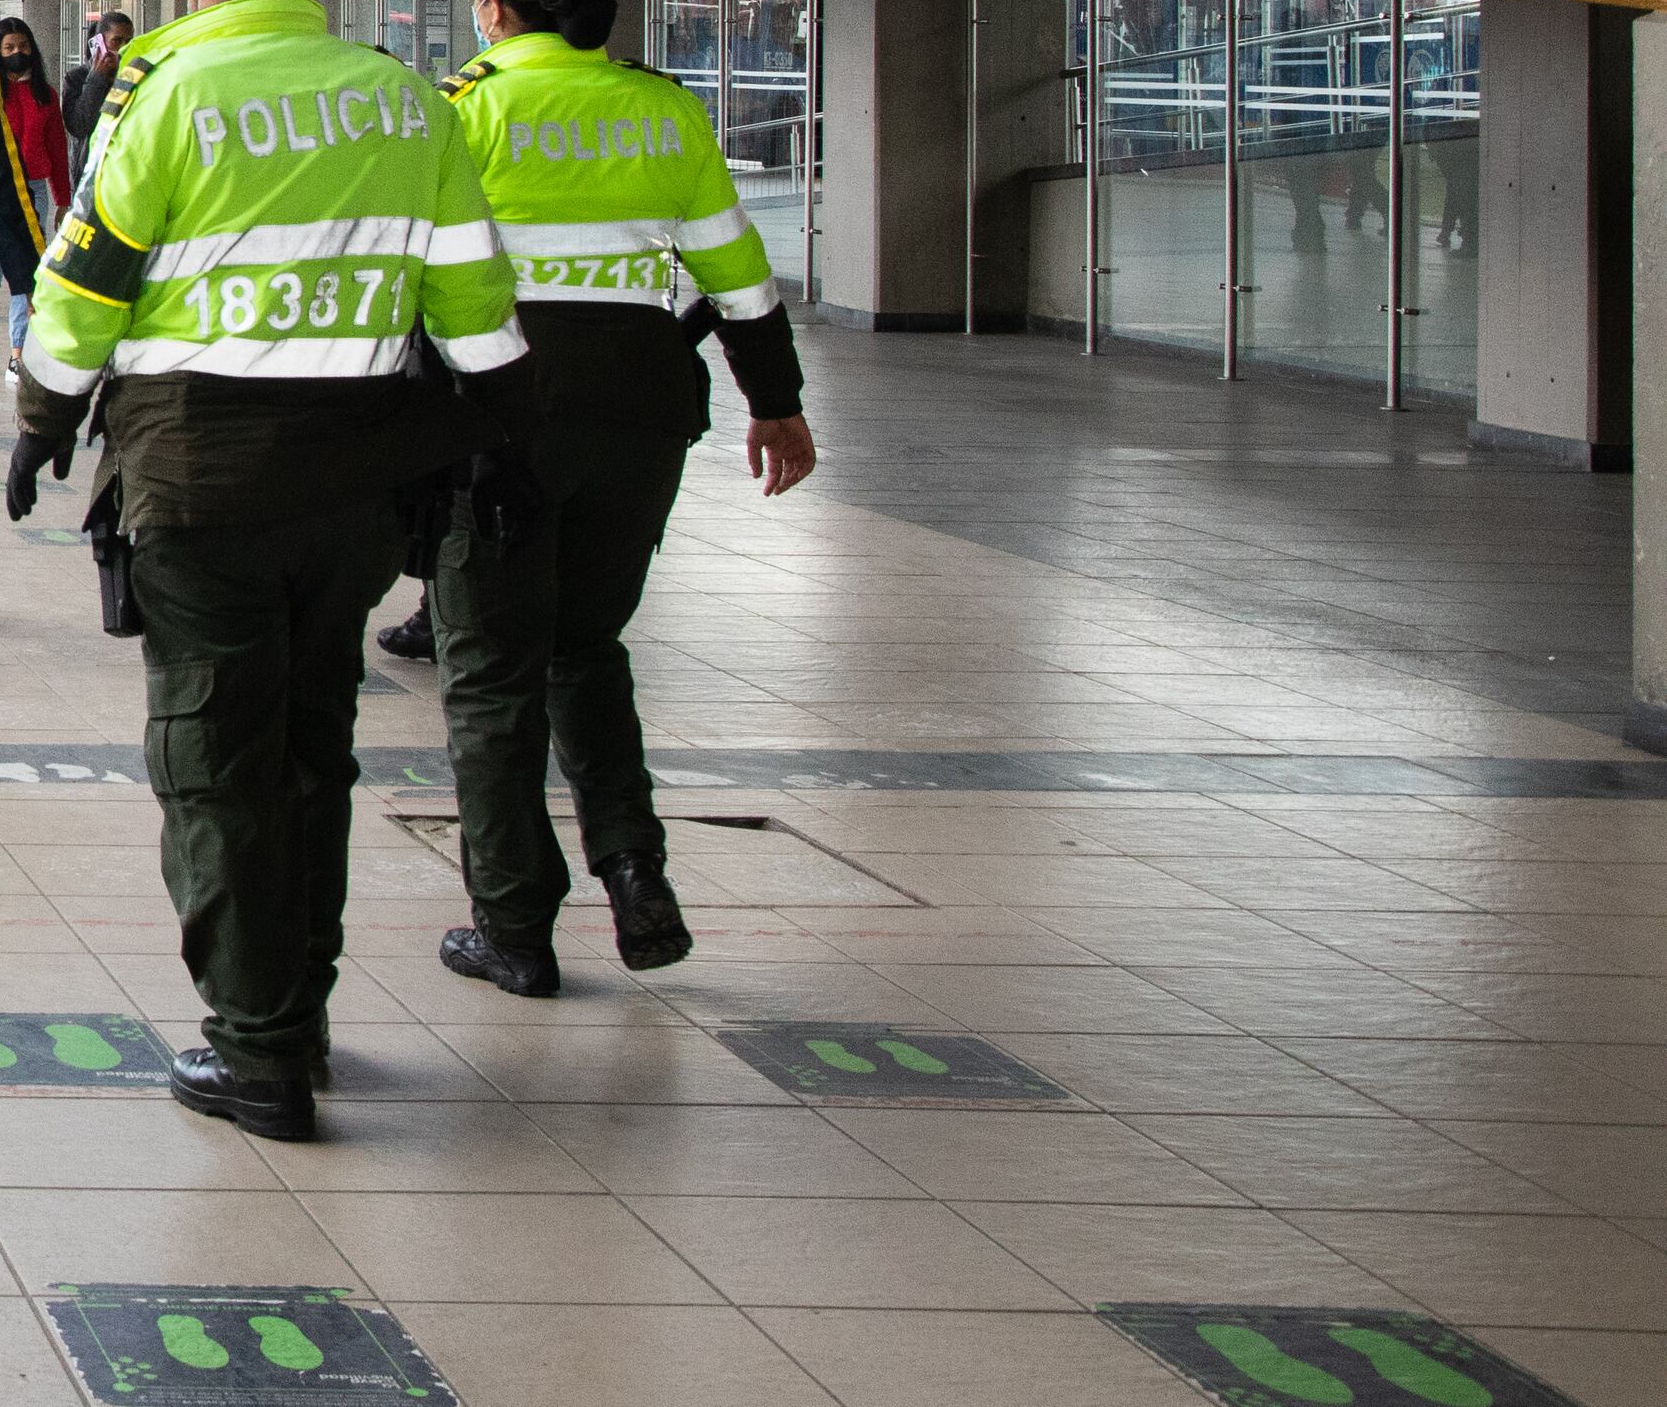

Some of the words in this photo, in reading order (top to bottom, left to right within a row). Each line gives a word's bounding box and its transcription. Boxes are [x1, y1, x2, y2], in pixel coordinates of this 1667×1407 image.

[192, 85, 430, 168] POLICIA
[508, 117, 684, 163] POLICIA
[184, 267, 408, 339] 183871
